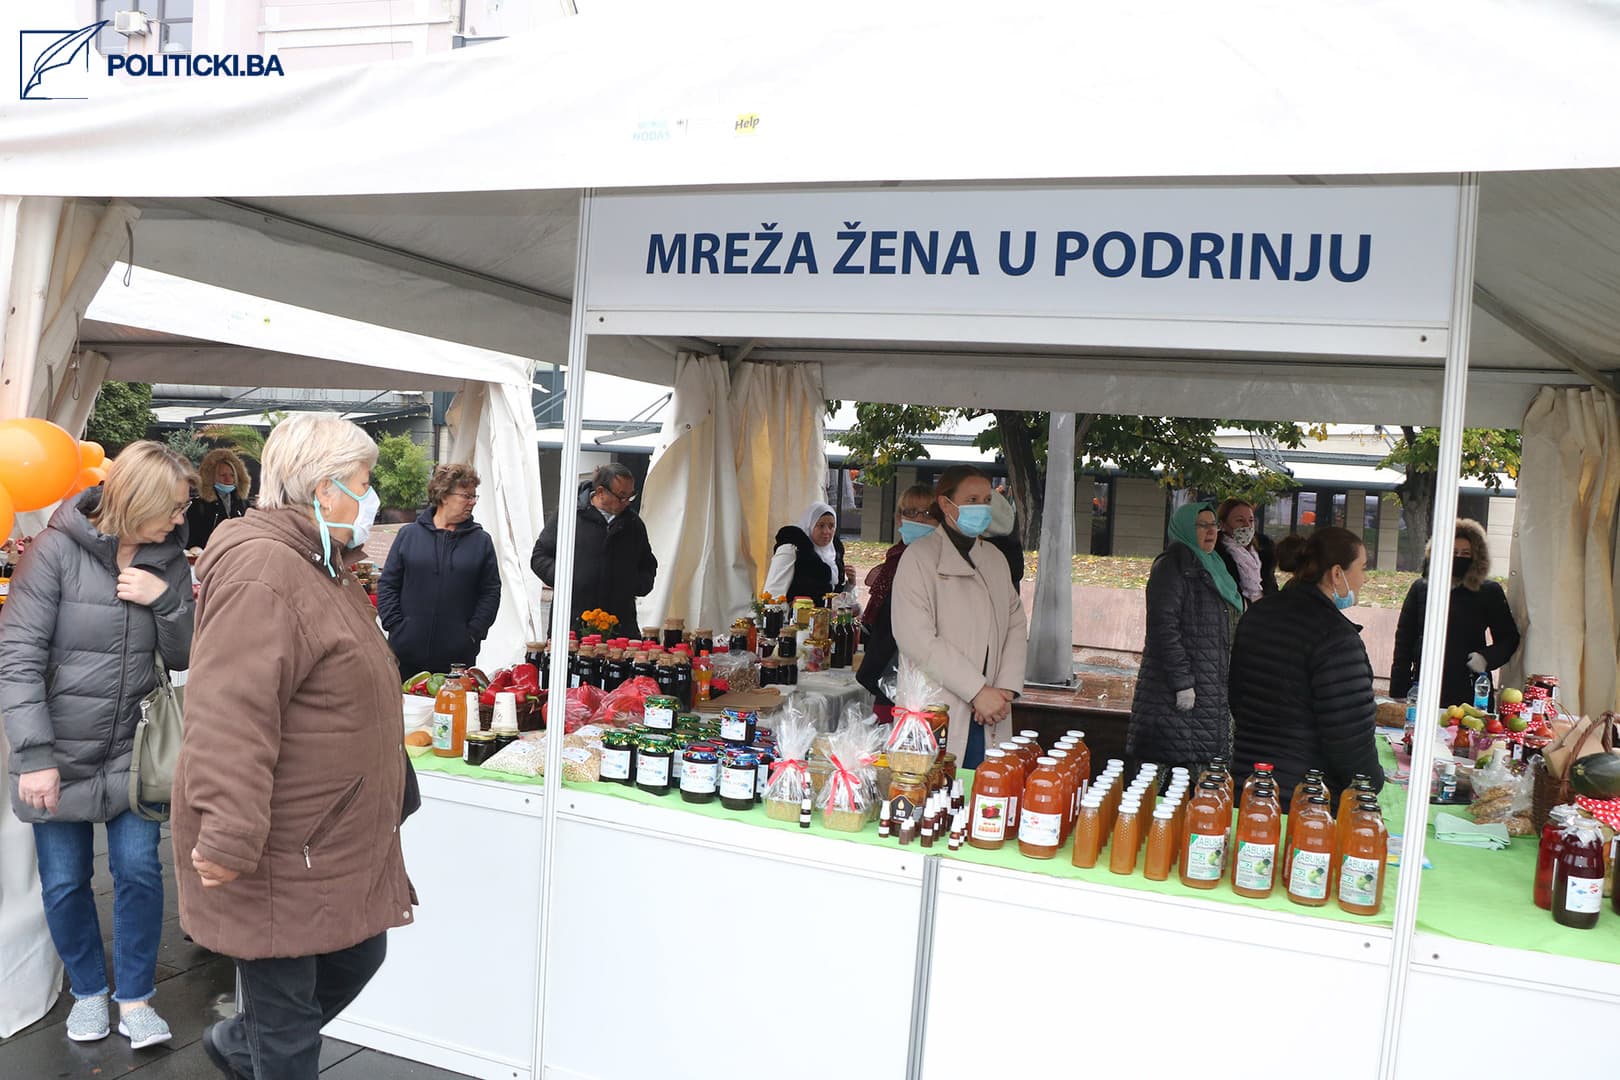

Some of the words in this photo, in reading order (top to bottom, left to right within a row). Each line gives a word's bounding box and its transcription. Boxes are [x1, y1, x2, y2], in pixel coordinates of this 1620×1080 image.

[734, 115, 760, 132] Help
[646, 222, 819, 275] MREŽA
[833, 221, 979, 276] ŽENA
[999, 231, 1036, 277] U
[1055, 231, 1372, 283] PODRINJU
